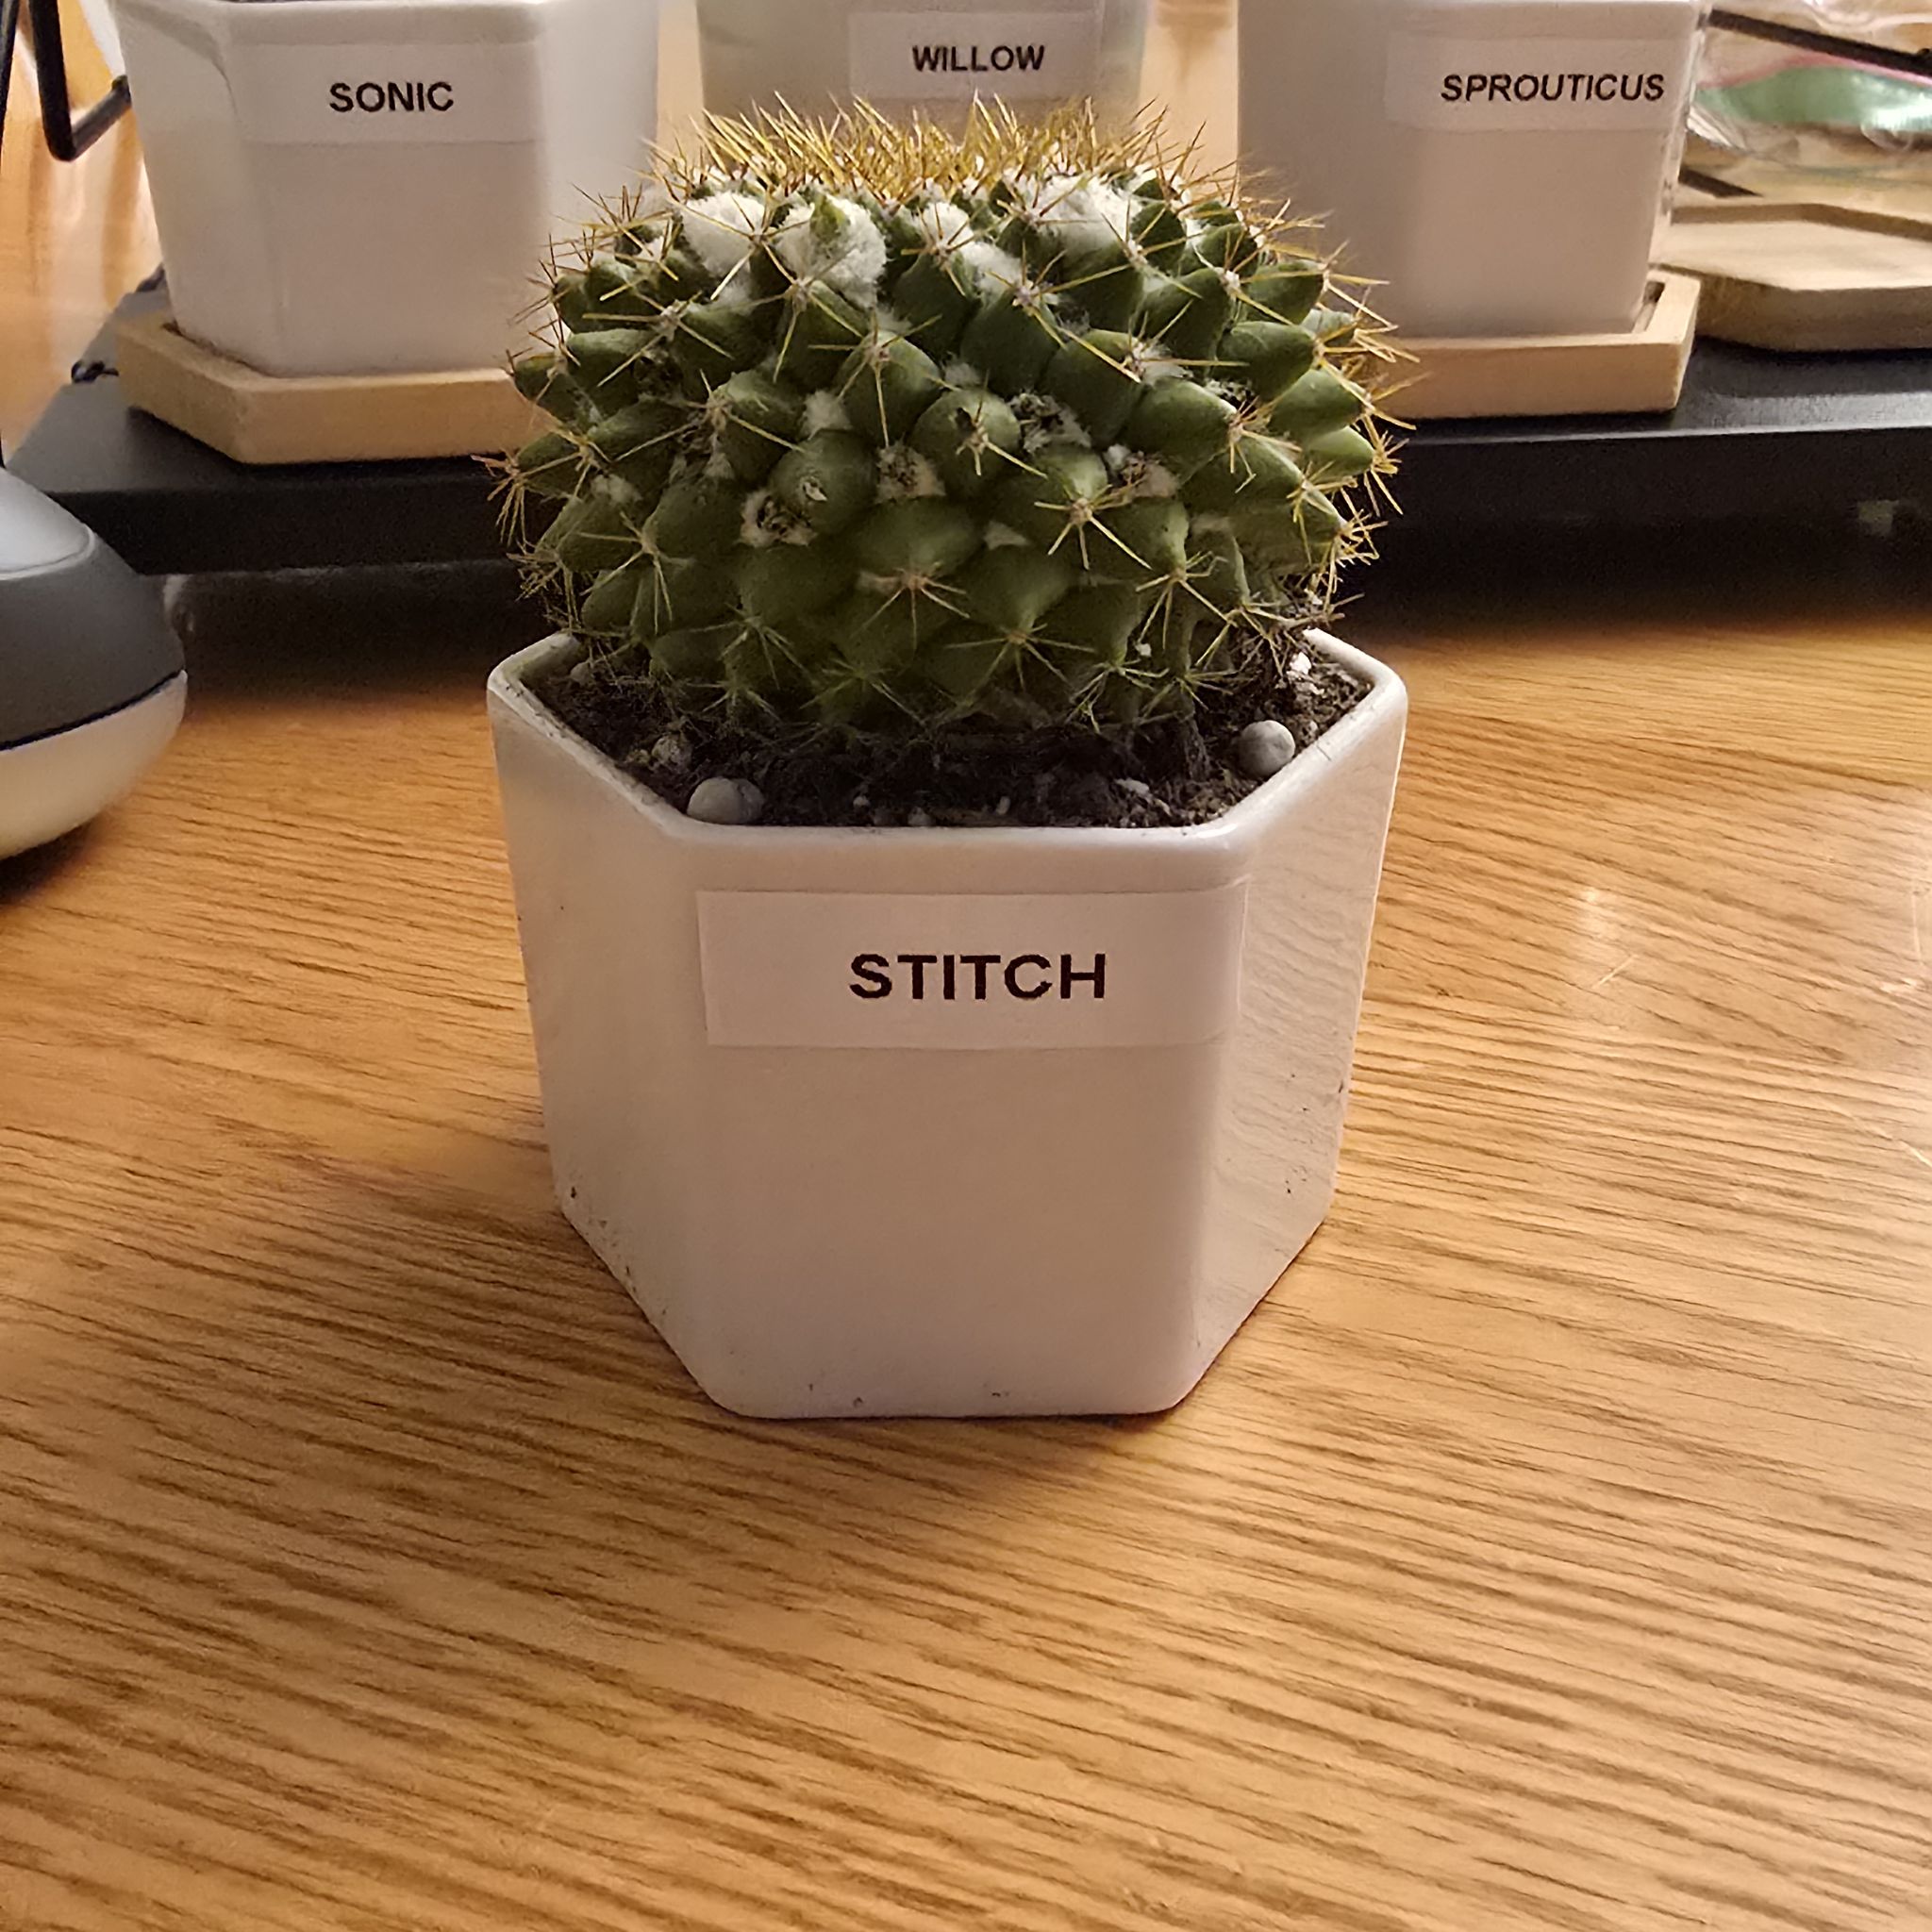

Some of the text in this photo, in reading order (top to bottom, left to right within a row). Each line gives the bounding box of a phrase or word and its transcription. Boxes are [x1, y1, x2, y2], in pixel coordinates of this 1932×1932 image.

[911, 44, 1045, 73] WILLOW
[329, 81, 455, 113] SONIC
[1441, 73, 1665, 102] SPROUTICUS
[849, 953, 1107, 1001] STITCH
